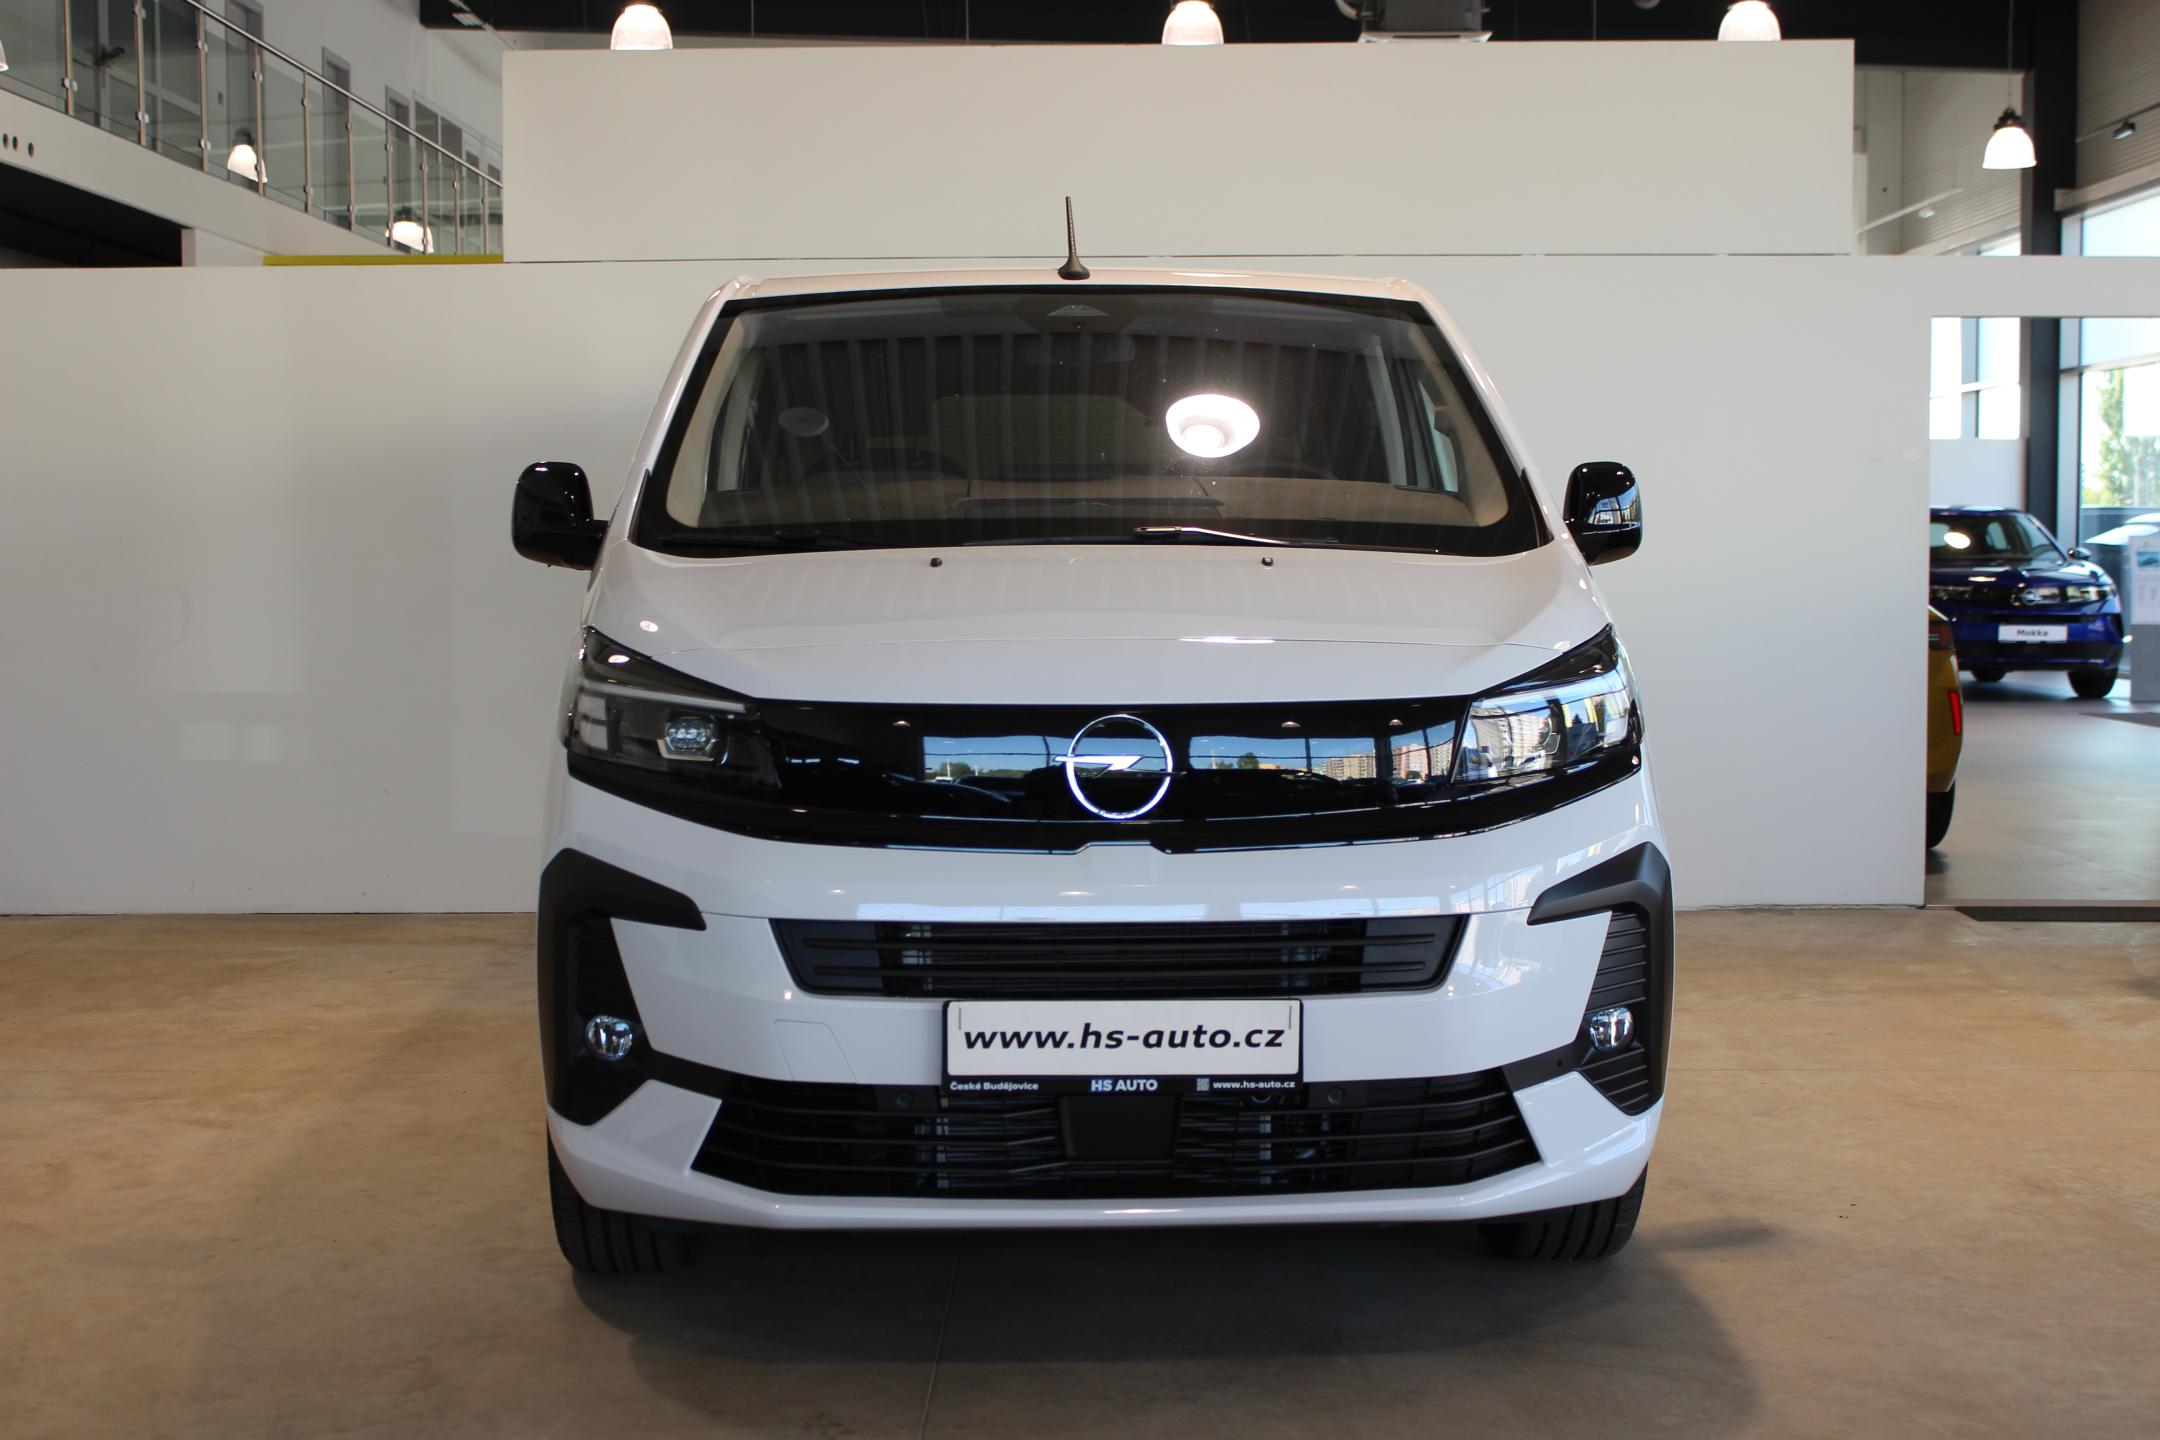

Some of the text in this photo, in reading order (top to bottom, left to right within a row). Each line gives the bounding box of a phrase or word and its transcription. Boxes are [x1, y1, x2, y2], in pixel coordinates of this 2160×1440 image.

[963, 1022, 1286, 1050] www.hs-auto.cz
[949, 1080, 1040, 1092] České Budějovice
[1090, 1078, 1158, 1092] HS AUTO
[1212, 1079, 1297, 1090] www.hs-auto.cz
